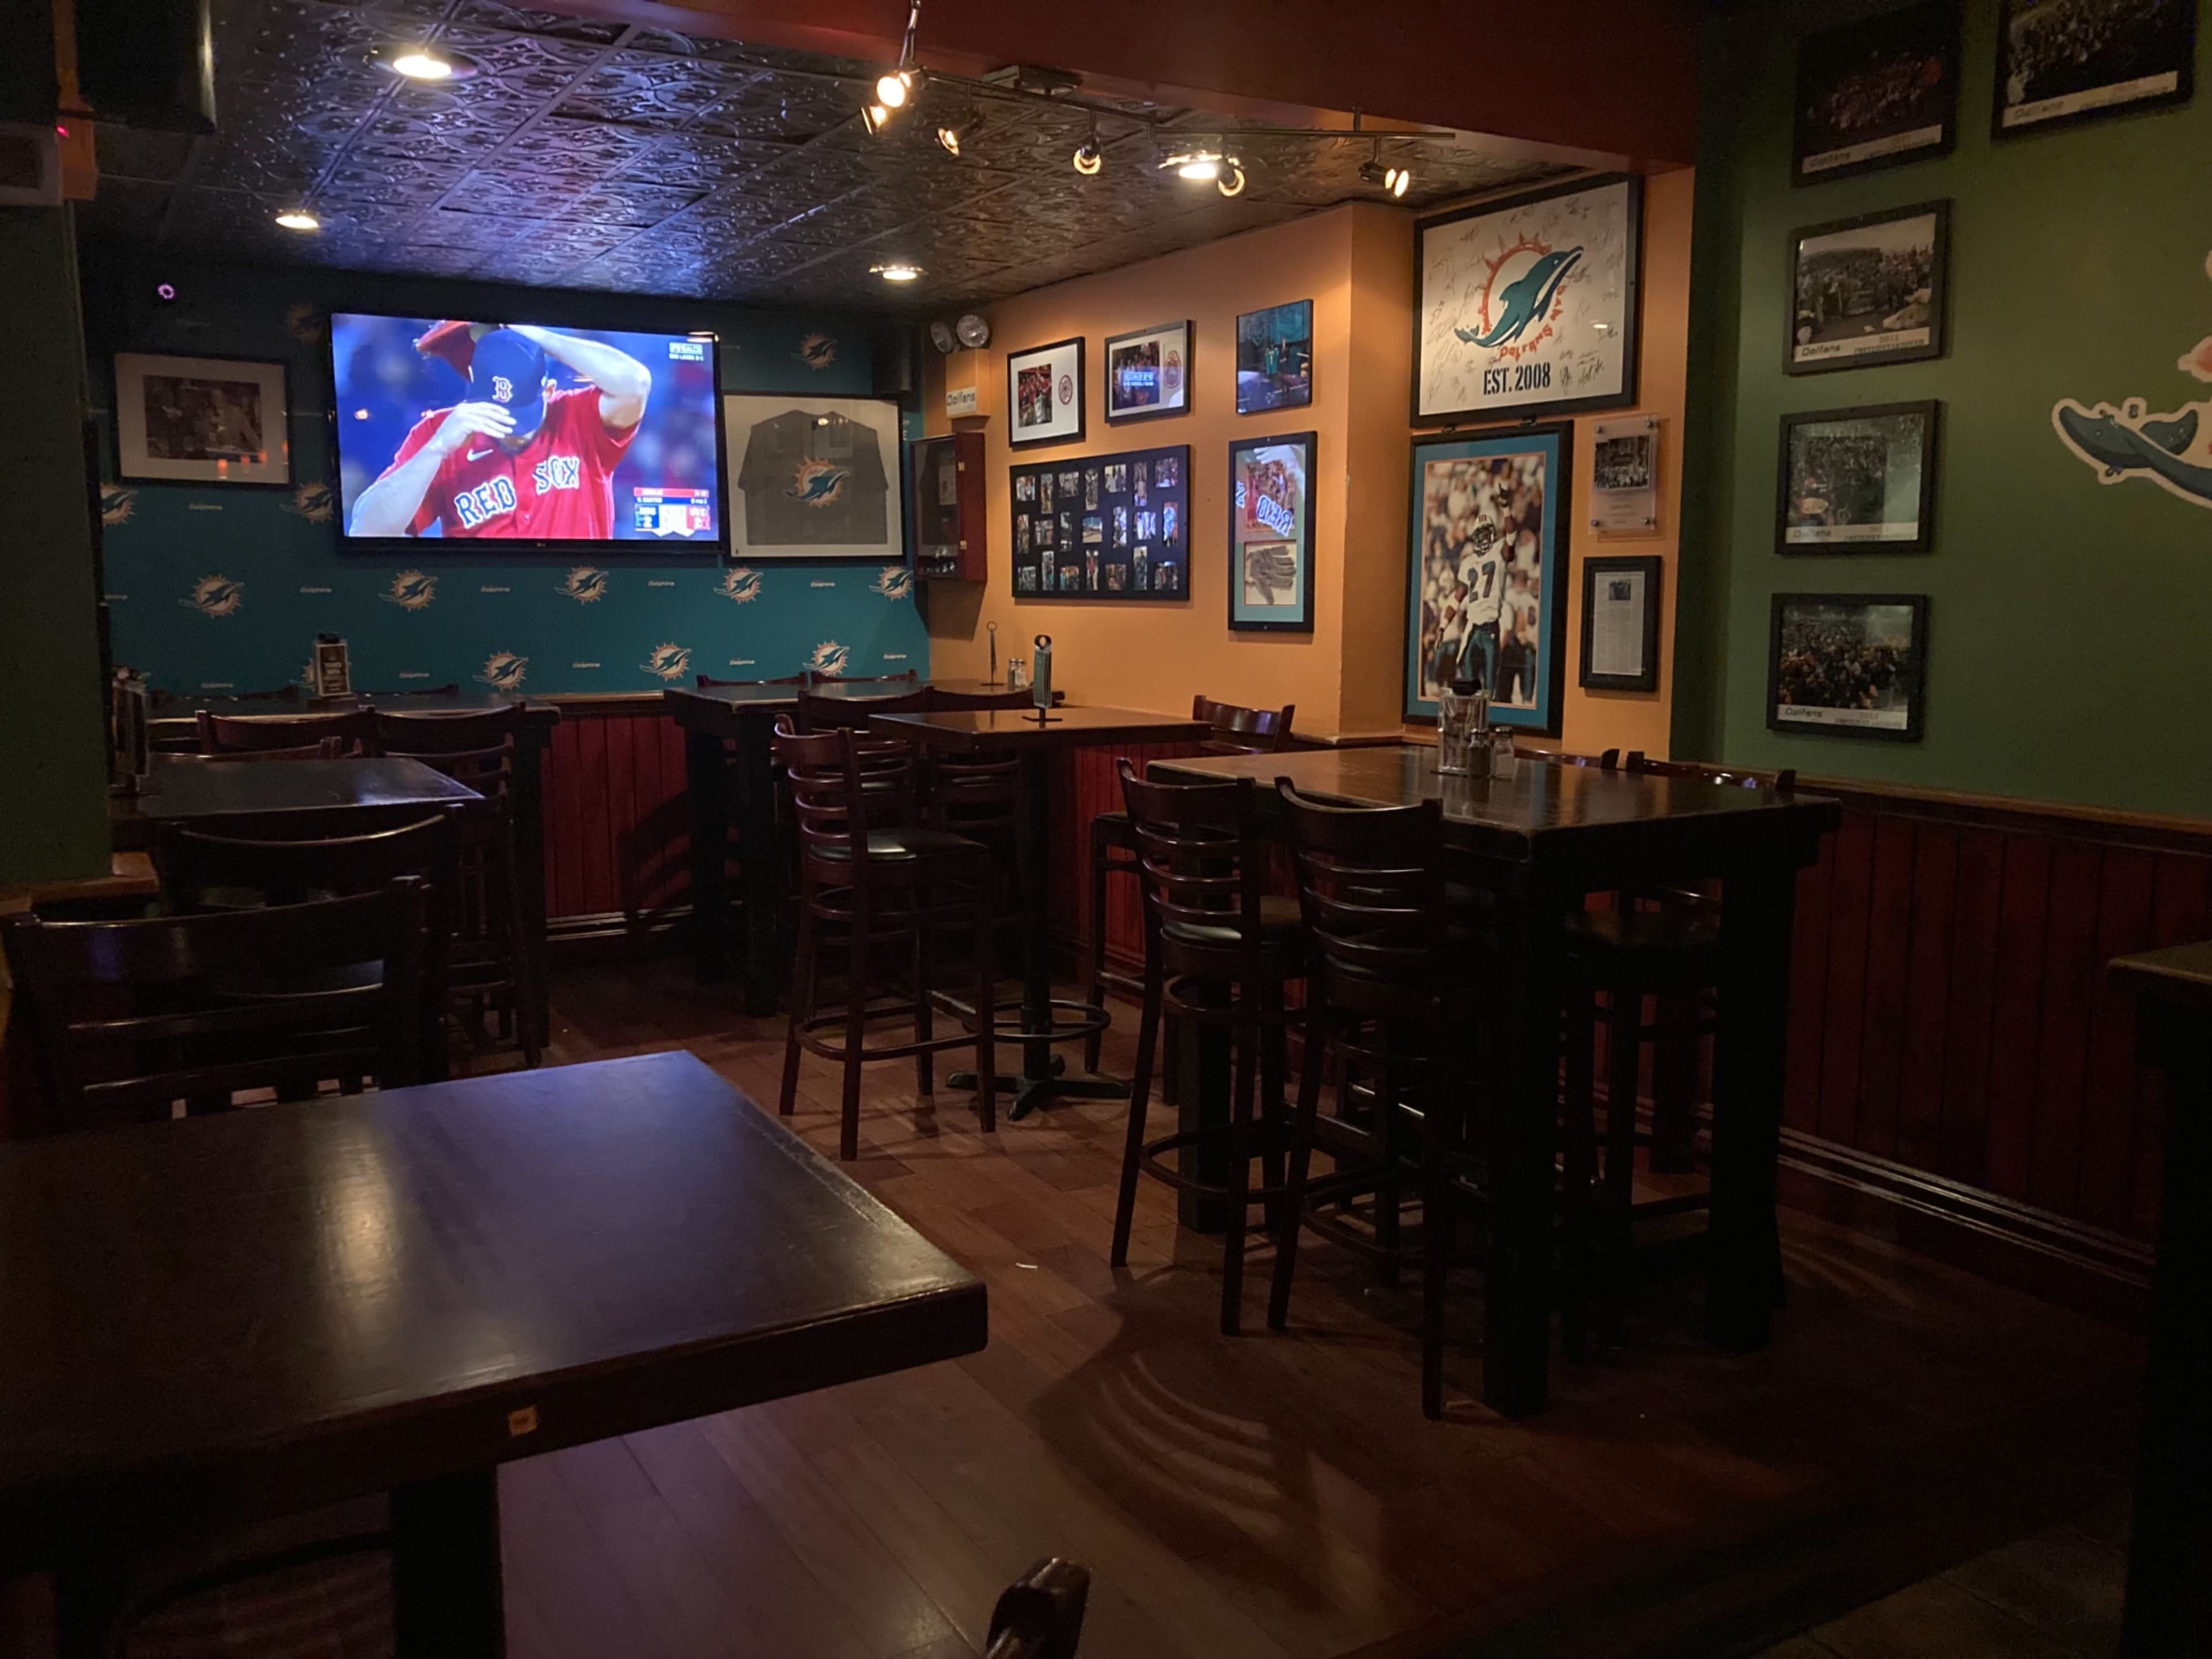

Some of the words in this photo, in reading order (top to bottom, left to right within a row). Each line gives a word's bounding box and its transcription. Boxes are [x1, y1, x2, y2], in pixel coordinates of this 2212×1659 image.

[1801, 344, 1841, 357] Dolfans
[492, 376, 513, 403] B
[1483, 368, 1512, 395] EST.
[1515, 362, 1551, 391] 2008
[947, 391, 975, 406] Dolfans
[532, 455, 579, 495] SOX
[454, 475, 516, 529] RED
[1468, 560, 1496, 603] 27
